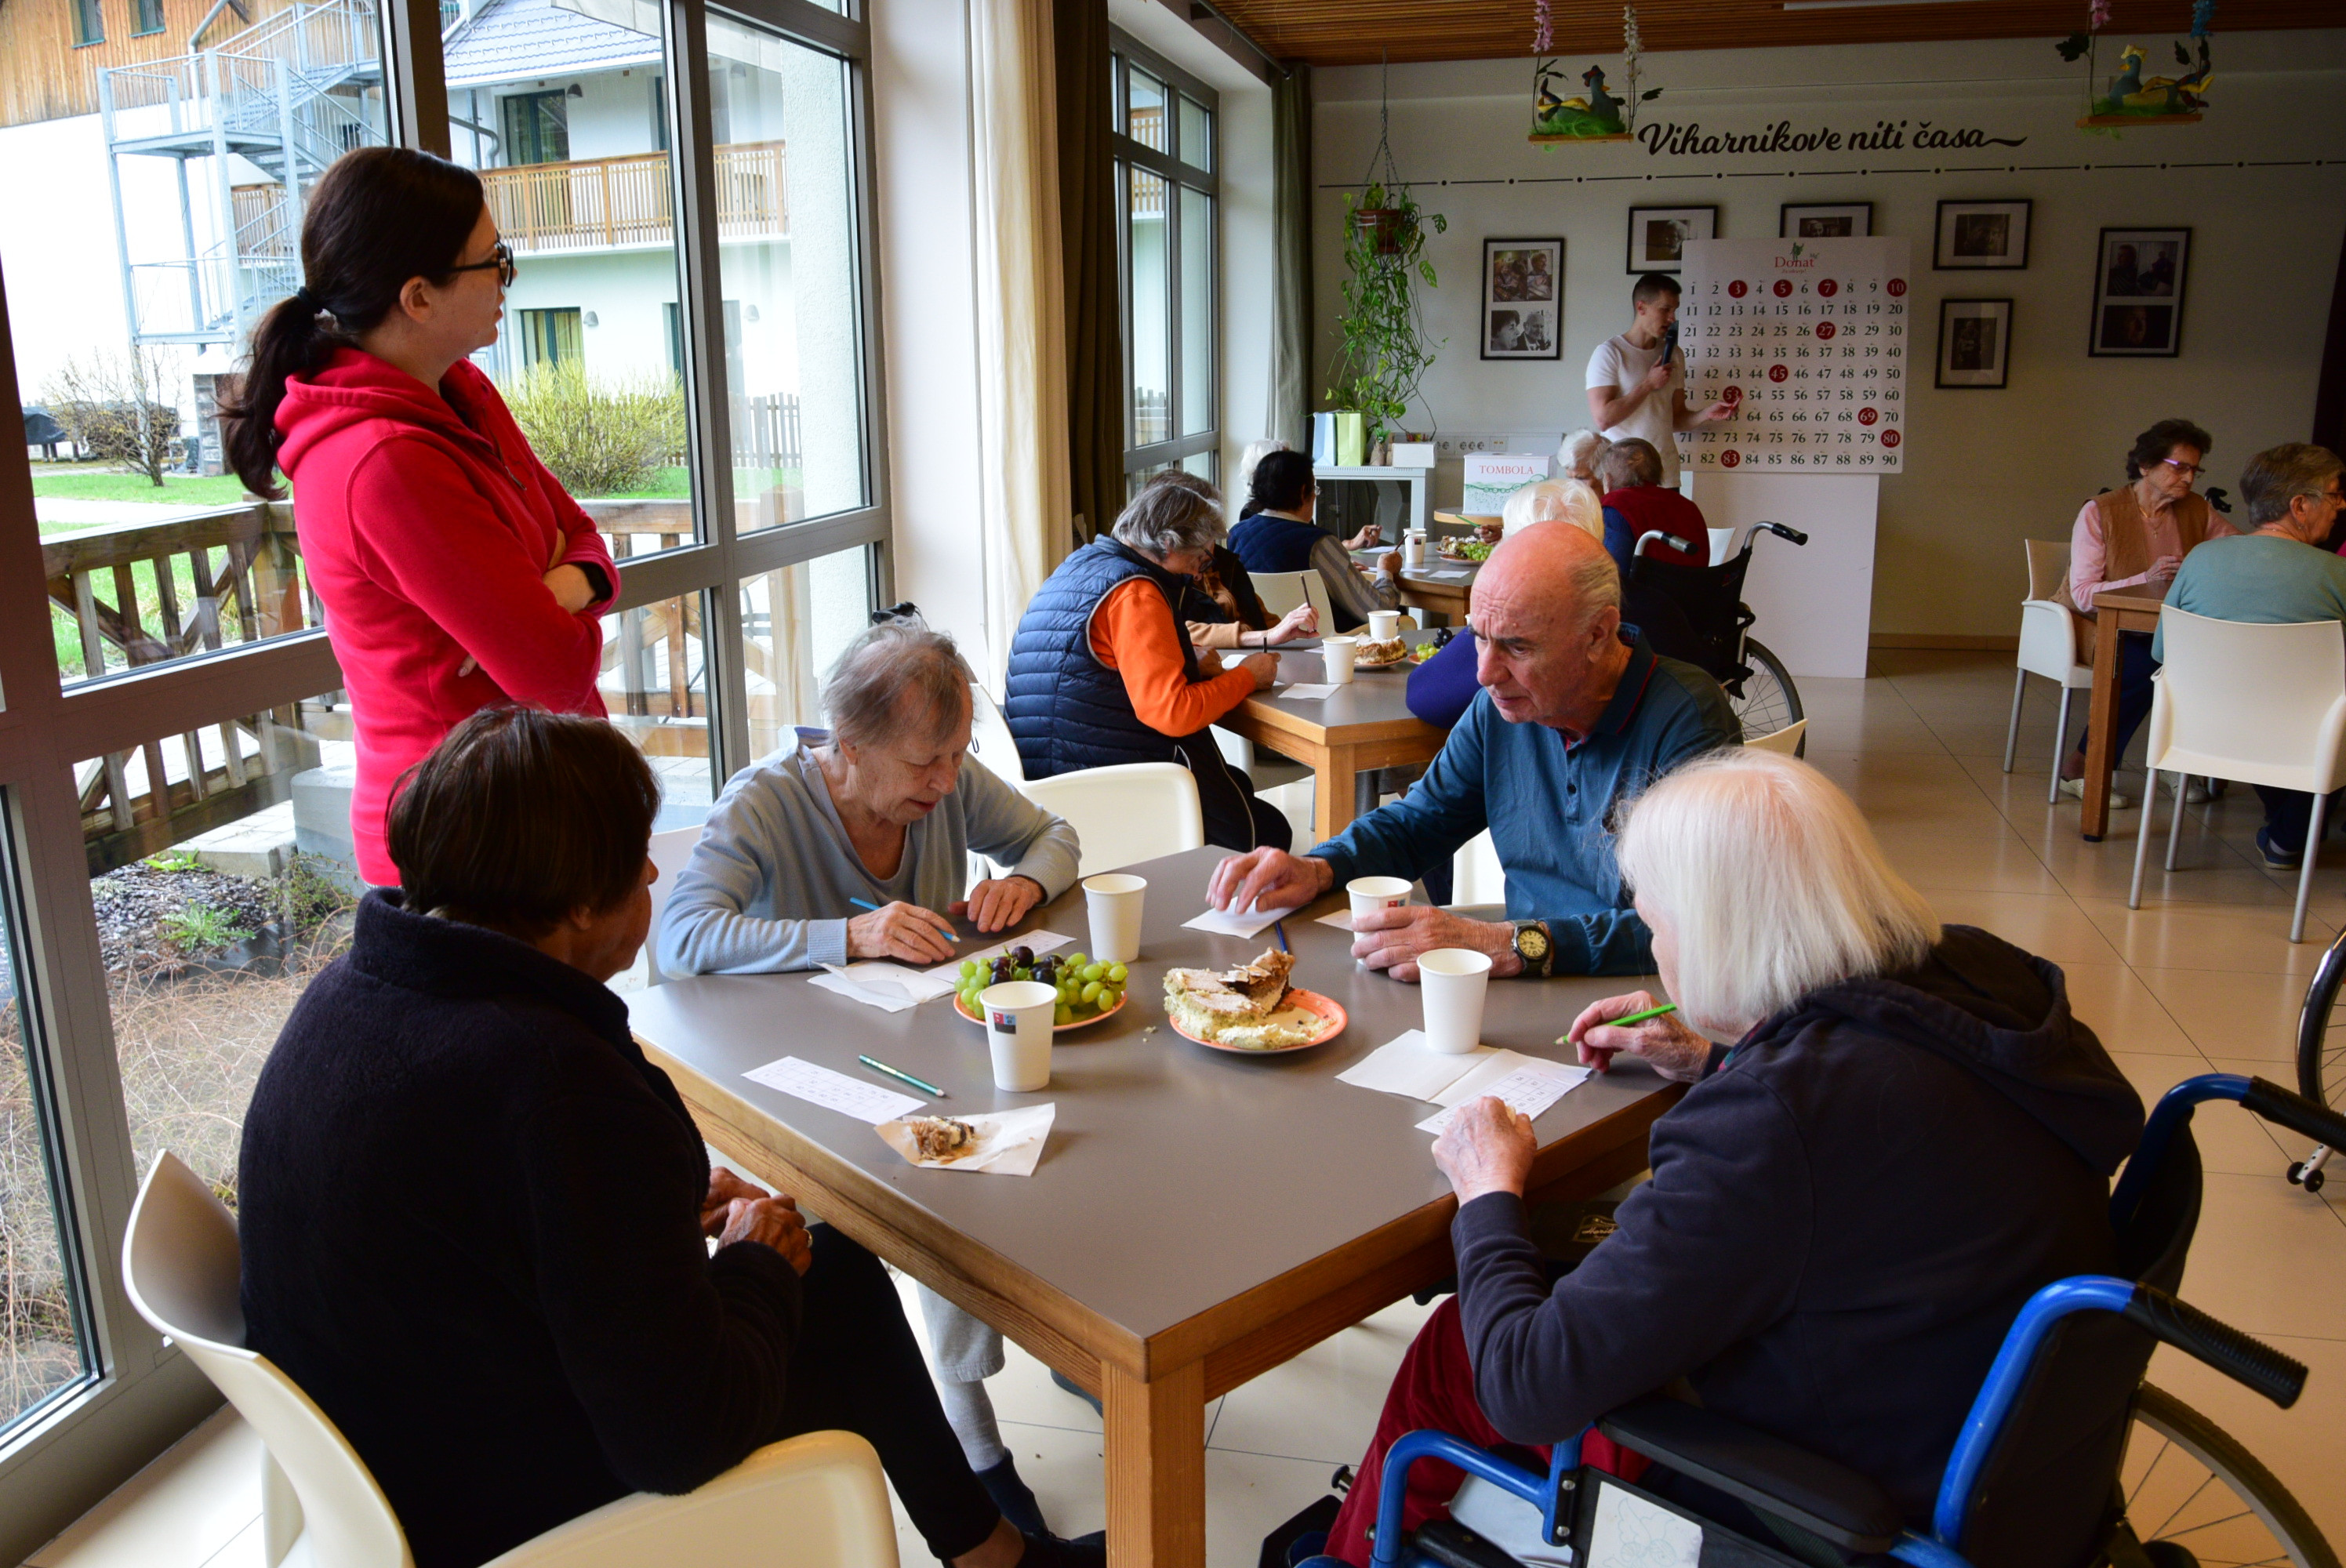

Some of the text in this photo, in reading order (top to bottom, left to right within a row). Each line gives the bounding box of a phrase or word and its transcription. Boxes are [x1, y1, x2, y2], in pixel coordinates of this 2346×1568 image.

[1637, 119, 2028, 155] Viharnikove niti časa
[1774, 256, 1814, 267] Donat
[1690, 282, 1904, 296] 1 2 3 4 5 6 7 8 9 10
[1687, 304, 1903, 316] 11 12 13 14 15 16 17 18 19 20
[1684, 325, 1902, 337] 21 22 23 24 25 26 27 28 29 30
[1684, 347, 1901, 358] 31 32 33 34 35 36 37 38 39 40
[1704, 368, 1719, 379] 42
[1727, 368, 1741, 379] 43
[1749, 369, 1763, 379] 44
[1771, 369, 1785, 379] 45
[1794, 368, 1809, 379] 46
[1817, 368, 1832, 379] 47
[1839, 368, 1854, 379] 48
[1862, 368, 1878, 379] 49
[1887, 368, 1901, 379] 50
[1705, 390, 1718, 400] 52
[1726, 390, 1739, 400] 53
[1749, 390, 1762, 400] 54
[1771, 390, 1785, 400] 55
[1794, 390, 1808, 400] 56
[1817, 390, 1831, 400] 57
[1839, 390, 1854, 400] 58
[1863, 390, 1877, 400] 59
[1884, 390, 1899, 401] 60
[1747, 412, 1761, 422] 64
[1770, 412, 1784, 422] 65
[1792, 412, 1807, 422] 66
[1815, 412, 1830, 422] 67
[1838, 412, 1853, 422] 68
[1860, 412, 1876, 421] 69
[1884, 412, 1899, 422] 70
[1680, 431, 1898, 444] 71 72 73 74 75 76 77 78 79 80
[1679, 453, 1897, 466] 81 82 83 84 85 86 87 88 89 90
[1479, 465, 1534, 474] TOMBOLA
